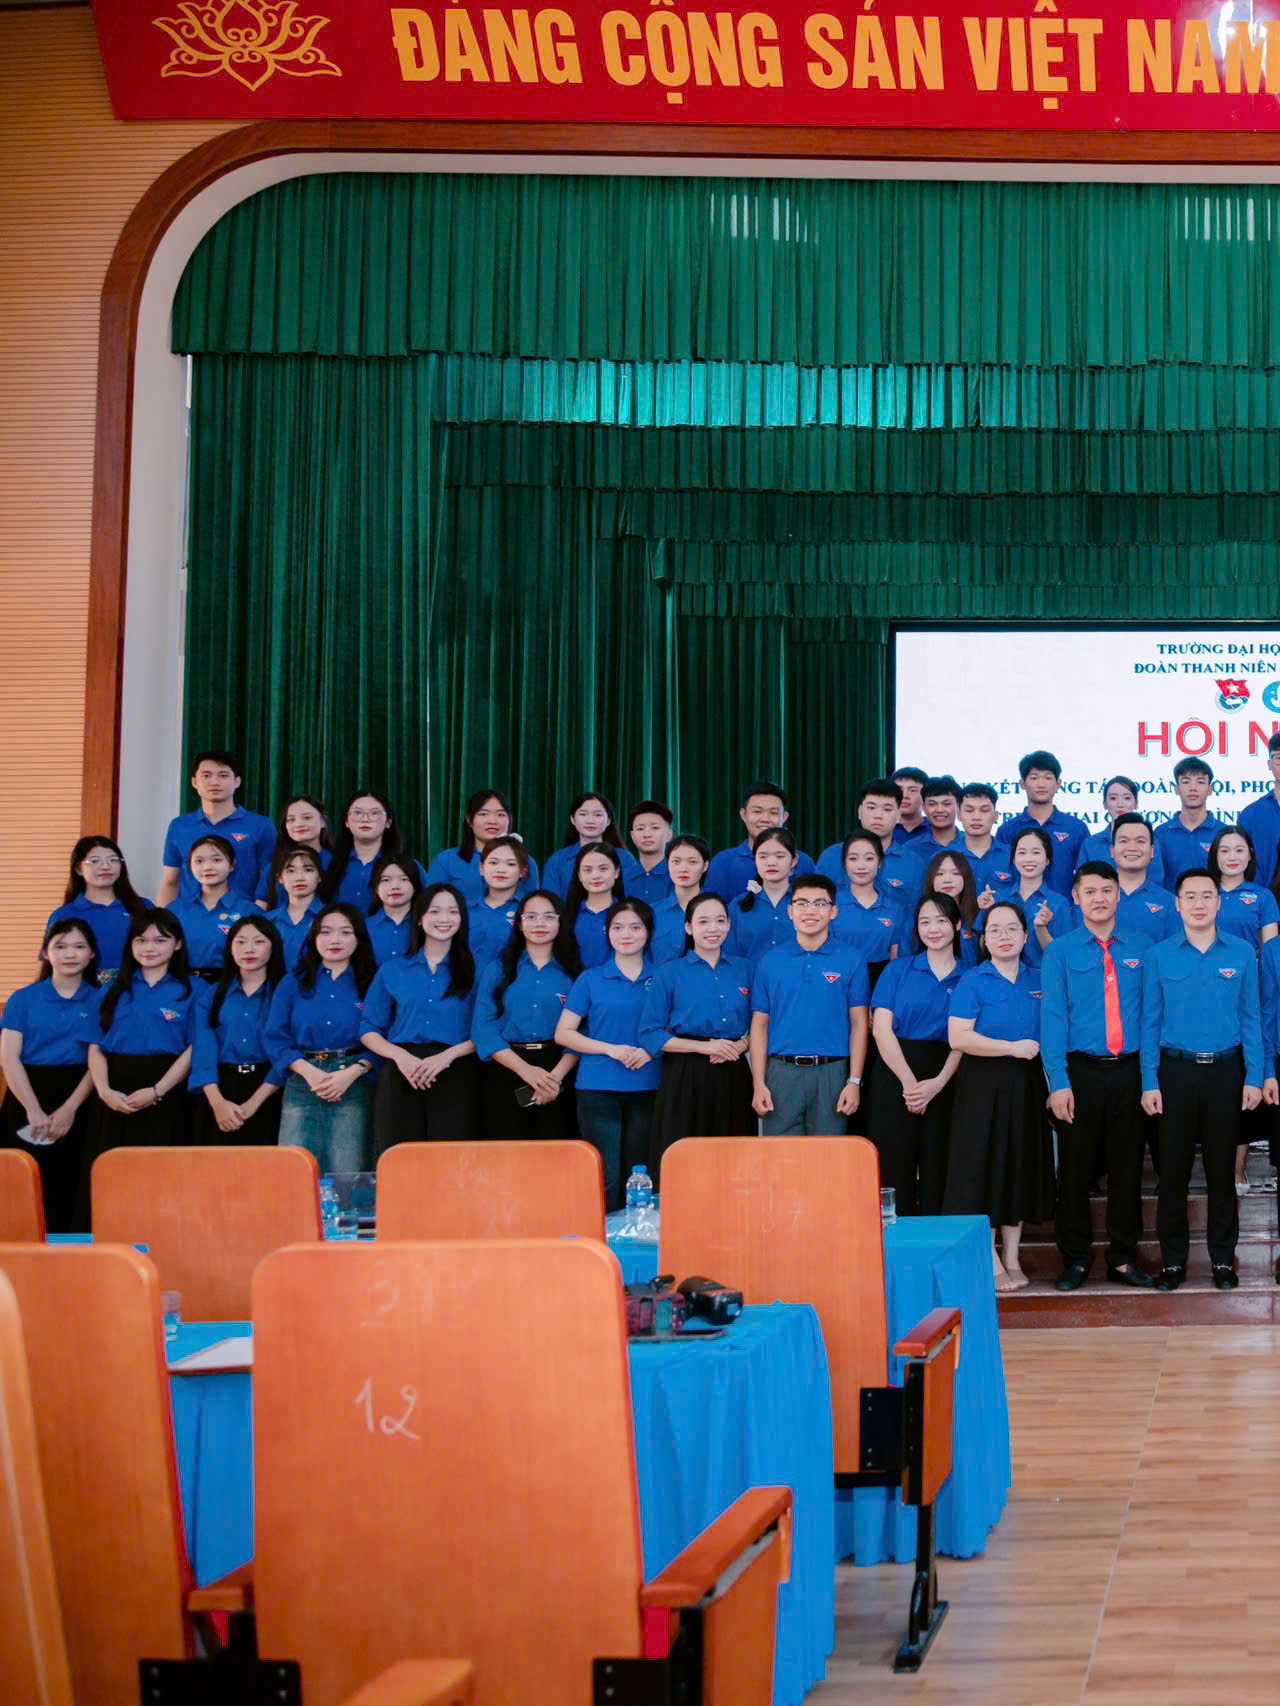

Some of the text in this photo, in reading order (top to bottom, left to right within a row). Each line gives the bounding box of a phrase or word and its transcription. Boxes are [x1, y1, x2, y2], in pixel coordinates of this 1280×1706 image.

[600, 0, 785, 104] CỘNG
[803, 0, 945, 91] SẢN
[962, 0, 1104, 110] VIỆT
[1134, 659, 1179, 674] ĐOÀN
[1181, 662, 1237, 674] THANH
[1239, 660, 1277, 674] NIÊN
[1156, 641, 1224, 655] TRƯỜNG
[1227, 643, 1255, 658] ĐẠI
[354, 1376, 421, 1440] 12
